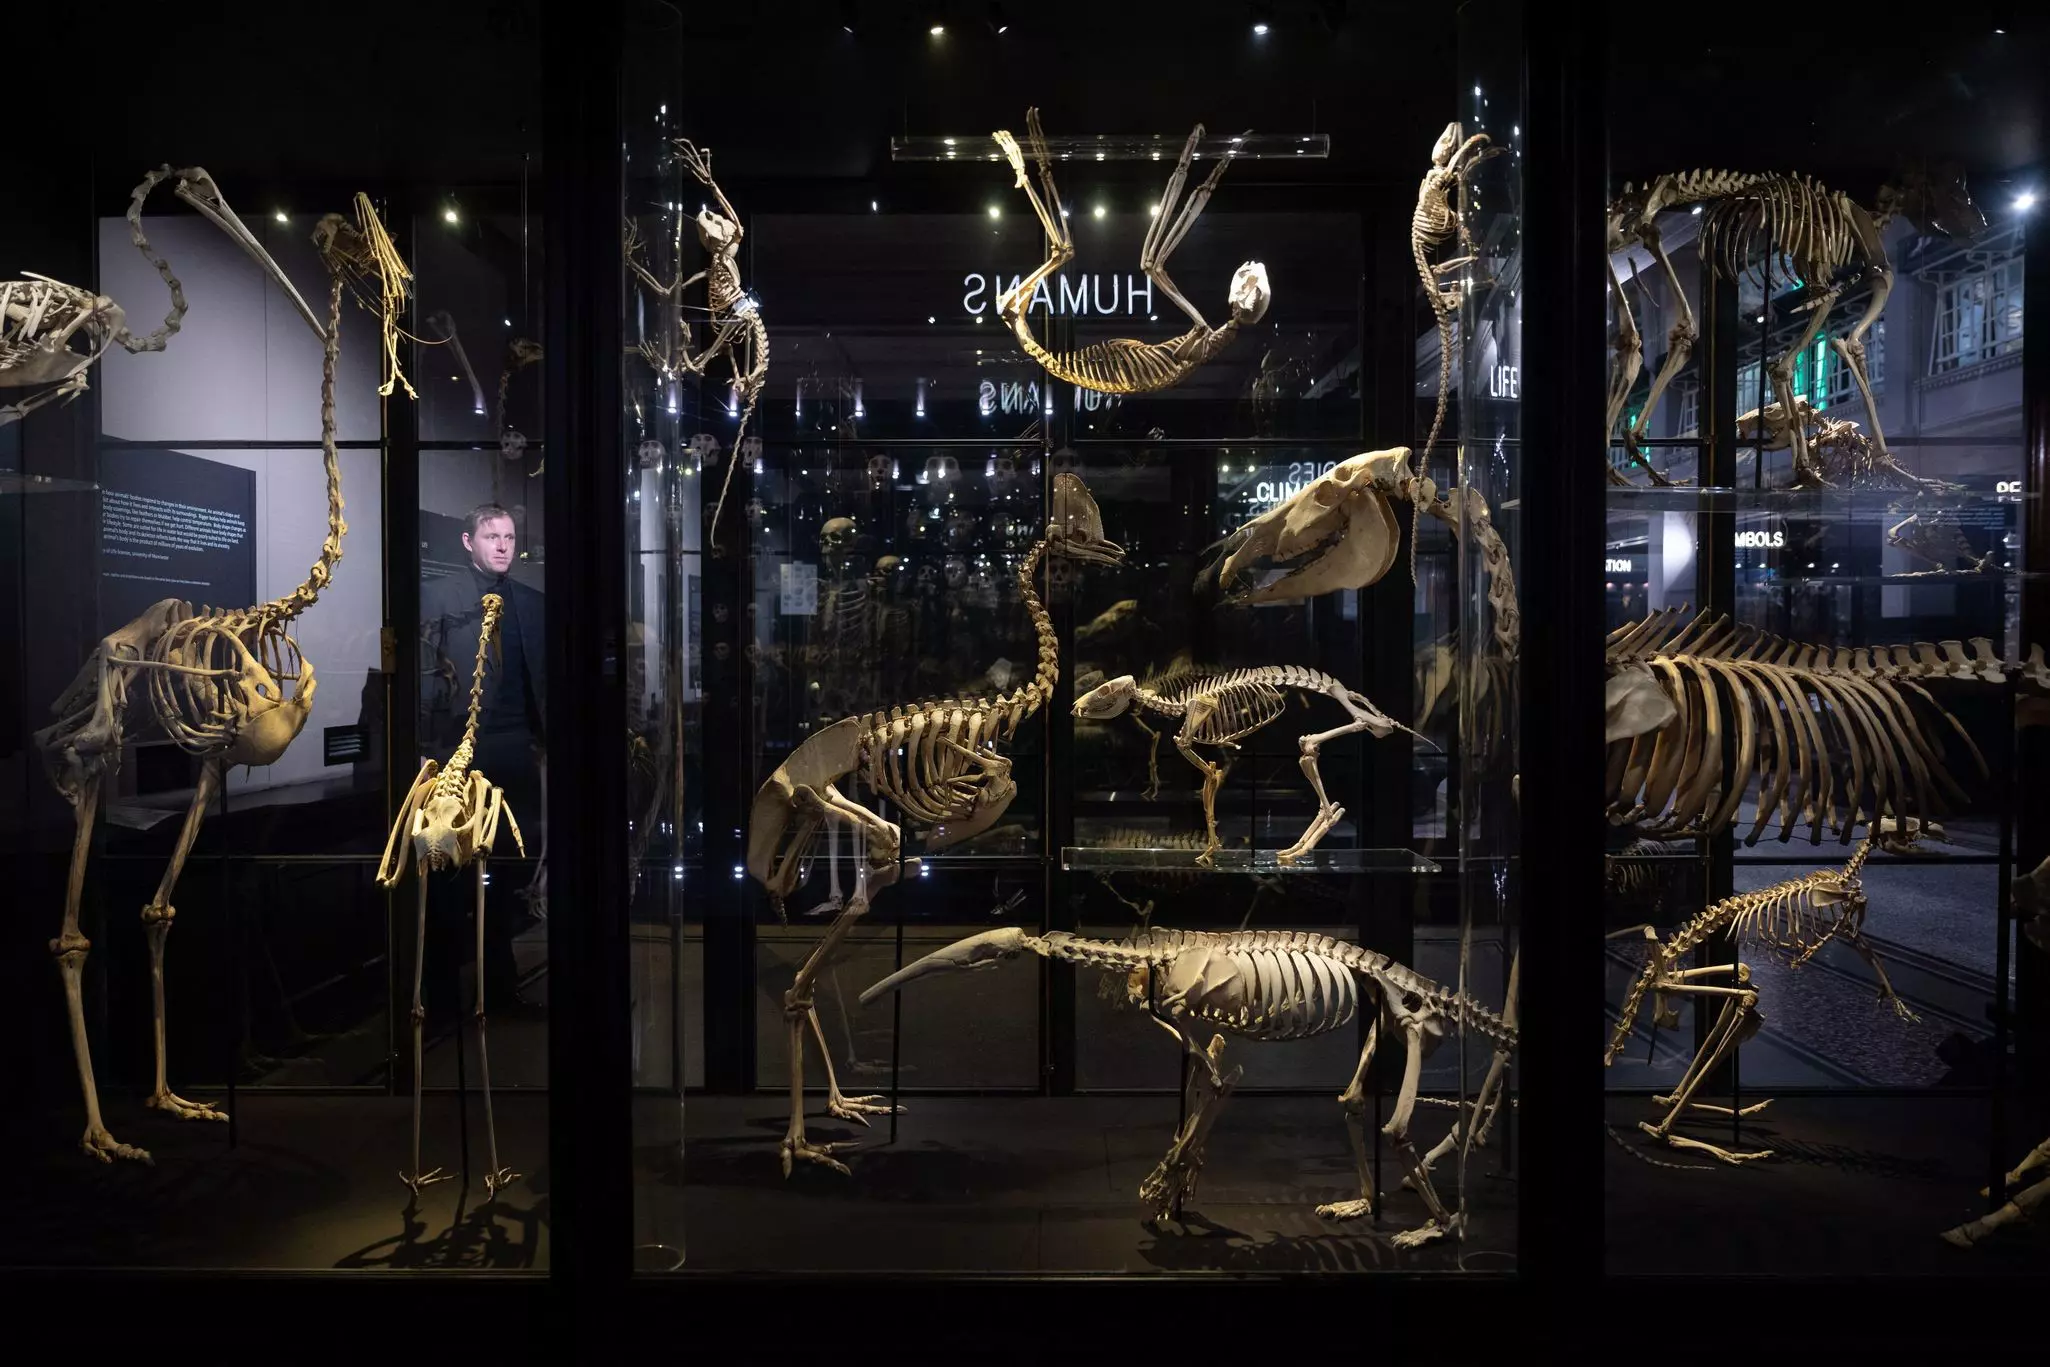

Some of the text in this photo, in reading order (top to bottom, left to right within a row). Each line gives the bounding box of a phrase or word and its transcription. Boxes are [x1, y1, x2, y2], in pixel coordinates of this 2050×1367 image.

[1490, 364, 1518, 399] LIFE
[1256, 481, 1309, 502] CLIM
[1605, 558, 1632, 573] TION
